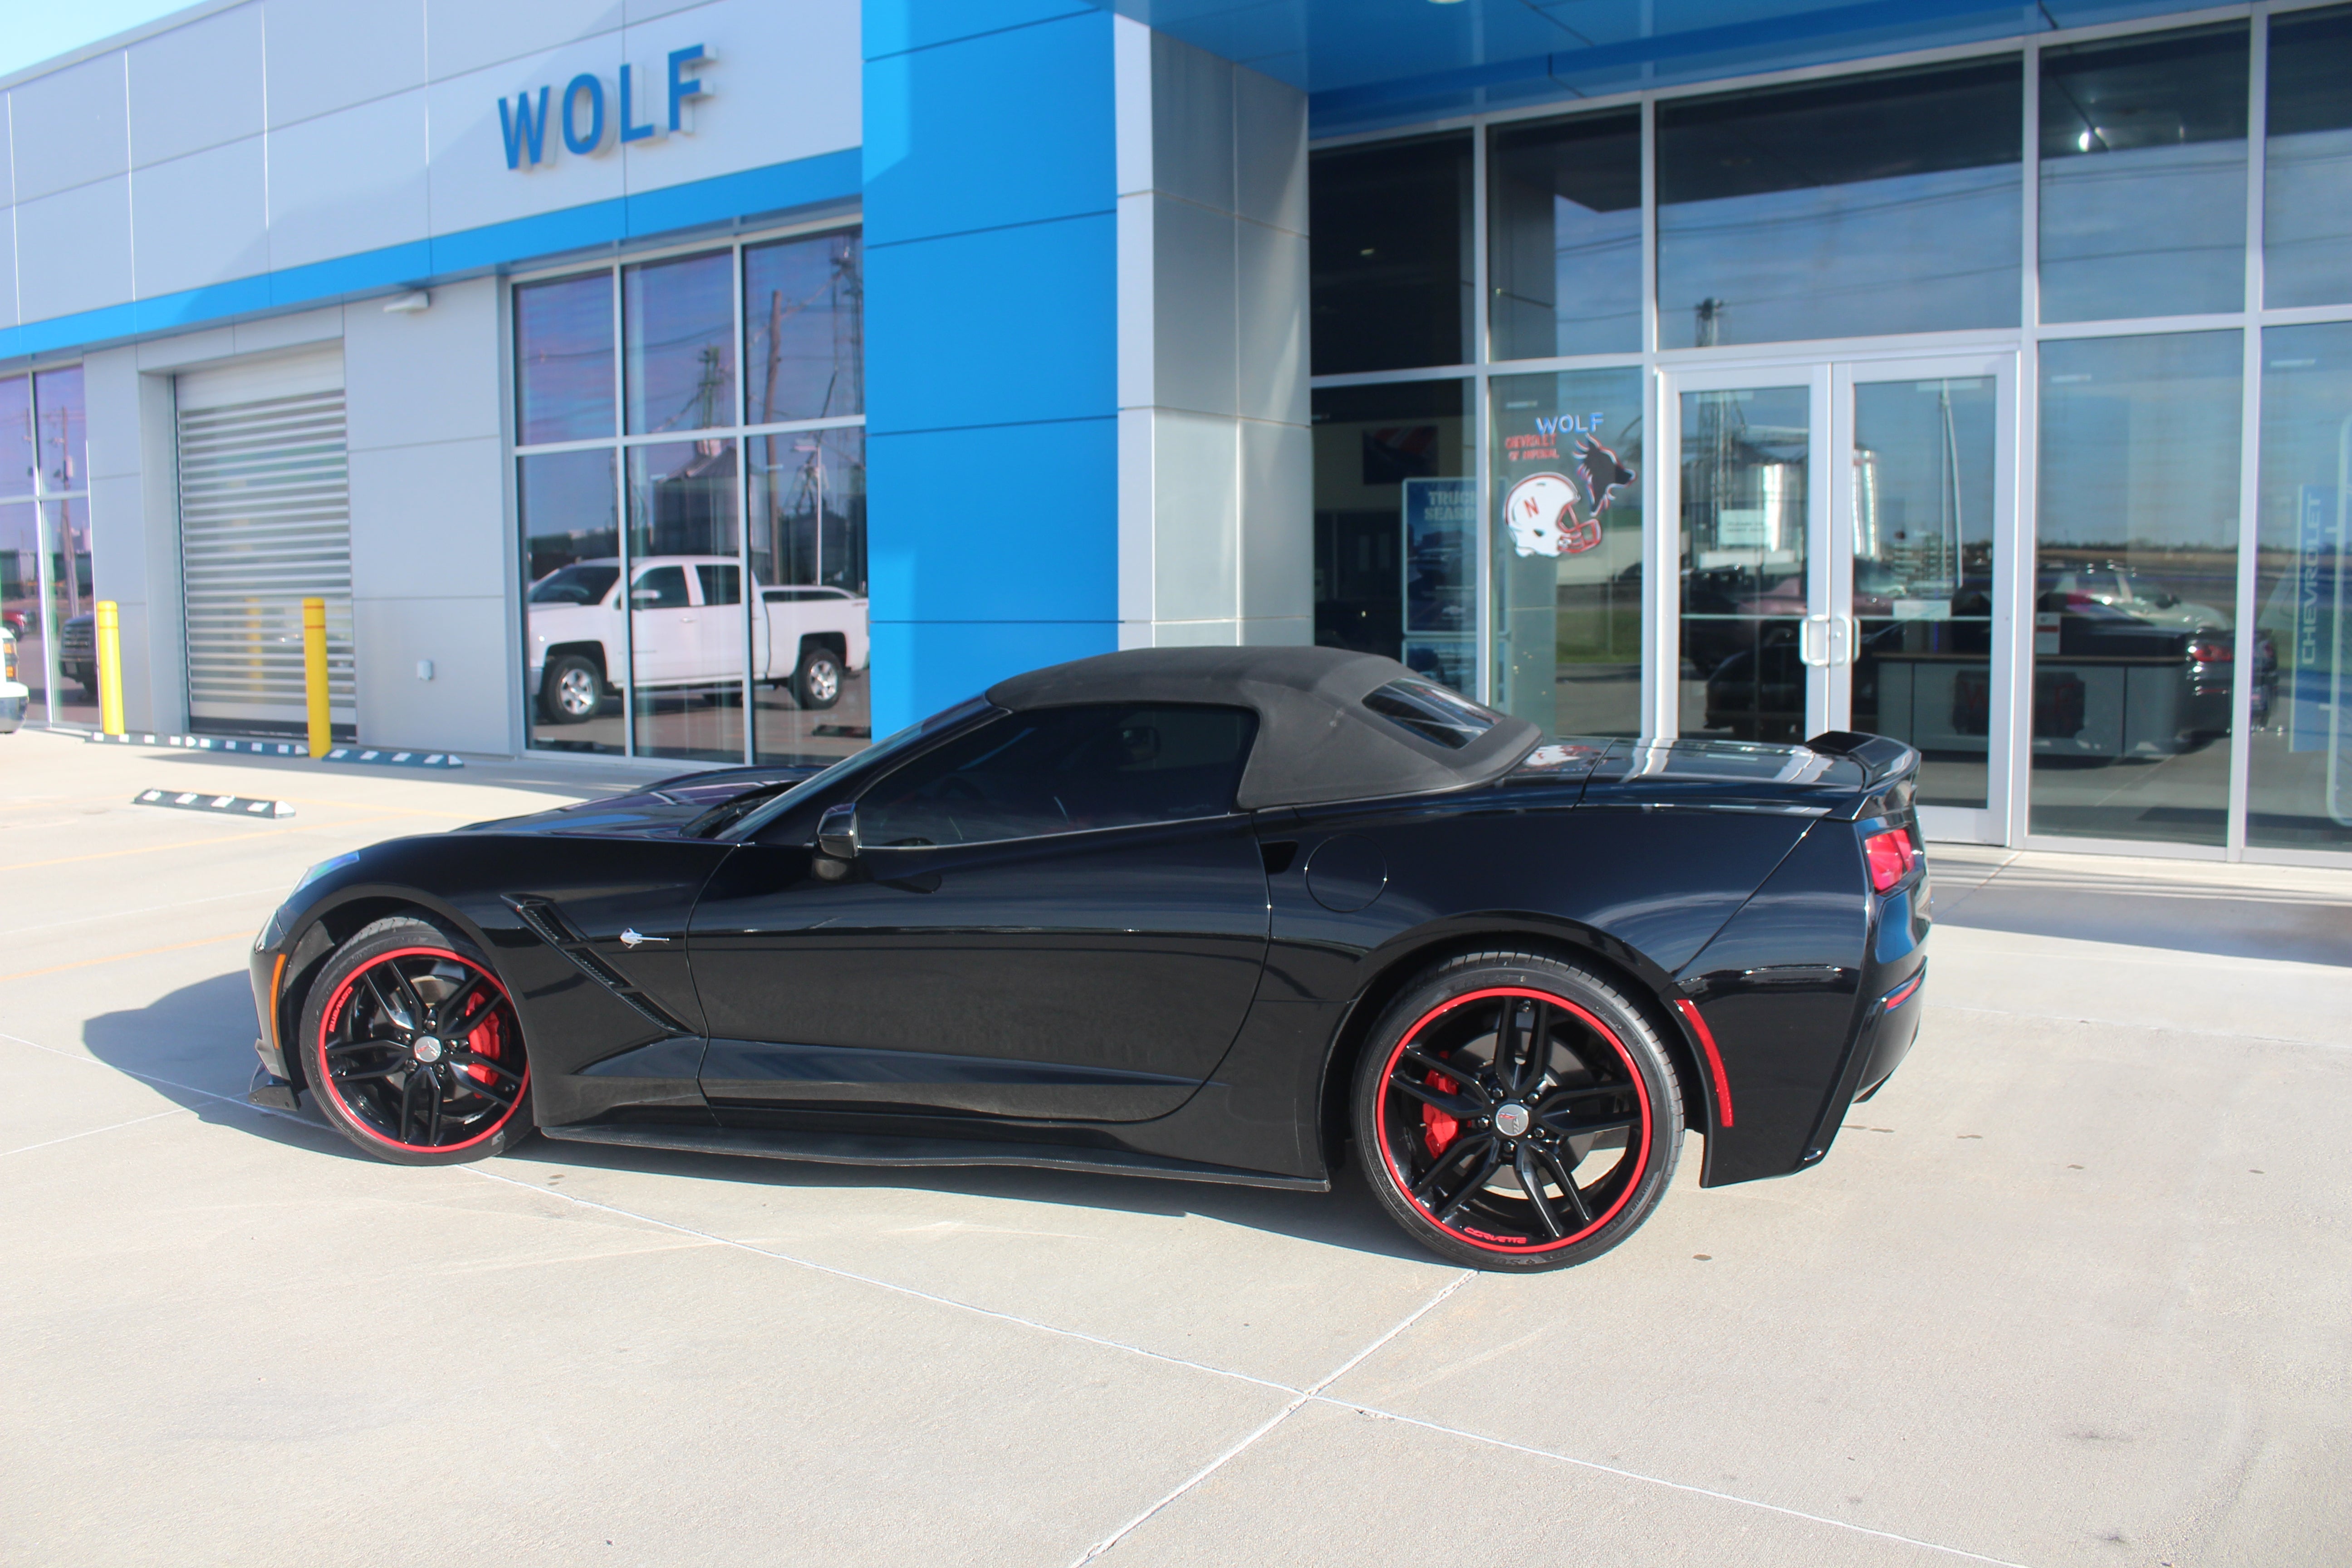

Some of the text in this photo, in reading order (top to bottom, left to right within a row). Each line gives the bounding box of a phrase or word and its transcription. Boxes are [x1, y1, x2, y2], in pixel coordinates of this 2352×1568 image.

[497, 43, 707, 171] WOLF
[1535, 412, 1604, 435] WOLF
[1424, 506, 1476, 521] SEASO
[1523, 496, 1540, 518] N
[2302, 492, 2320, 665] CHEVROLET
[1464, 1226, 1528, 1245] CORVETTE
